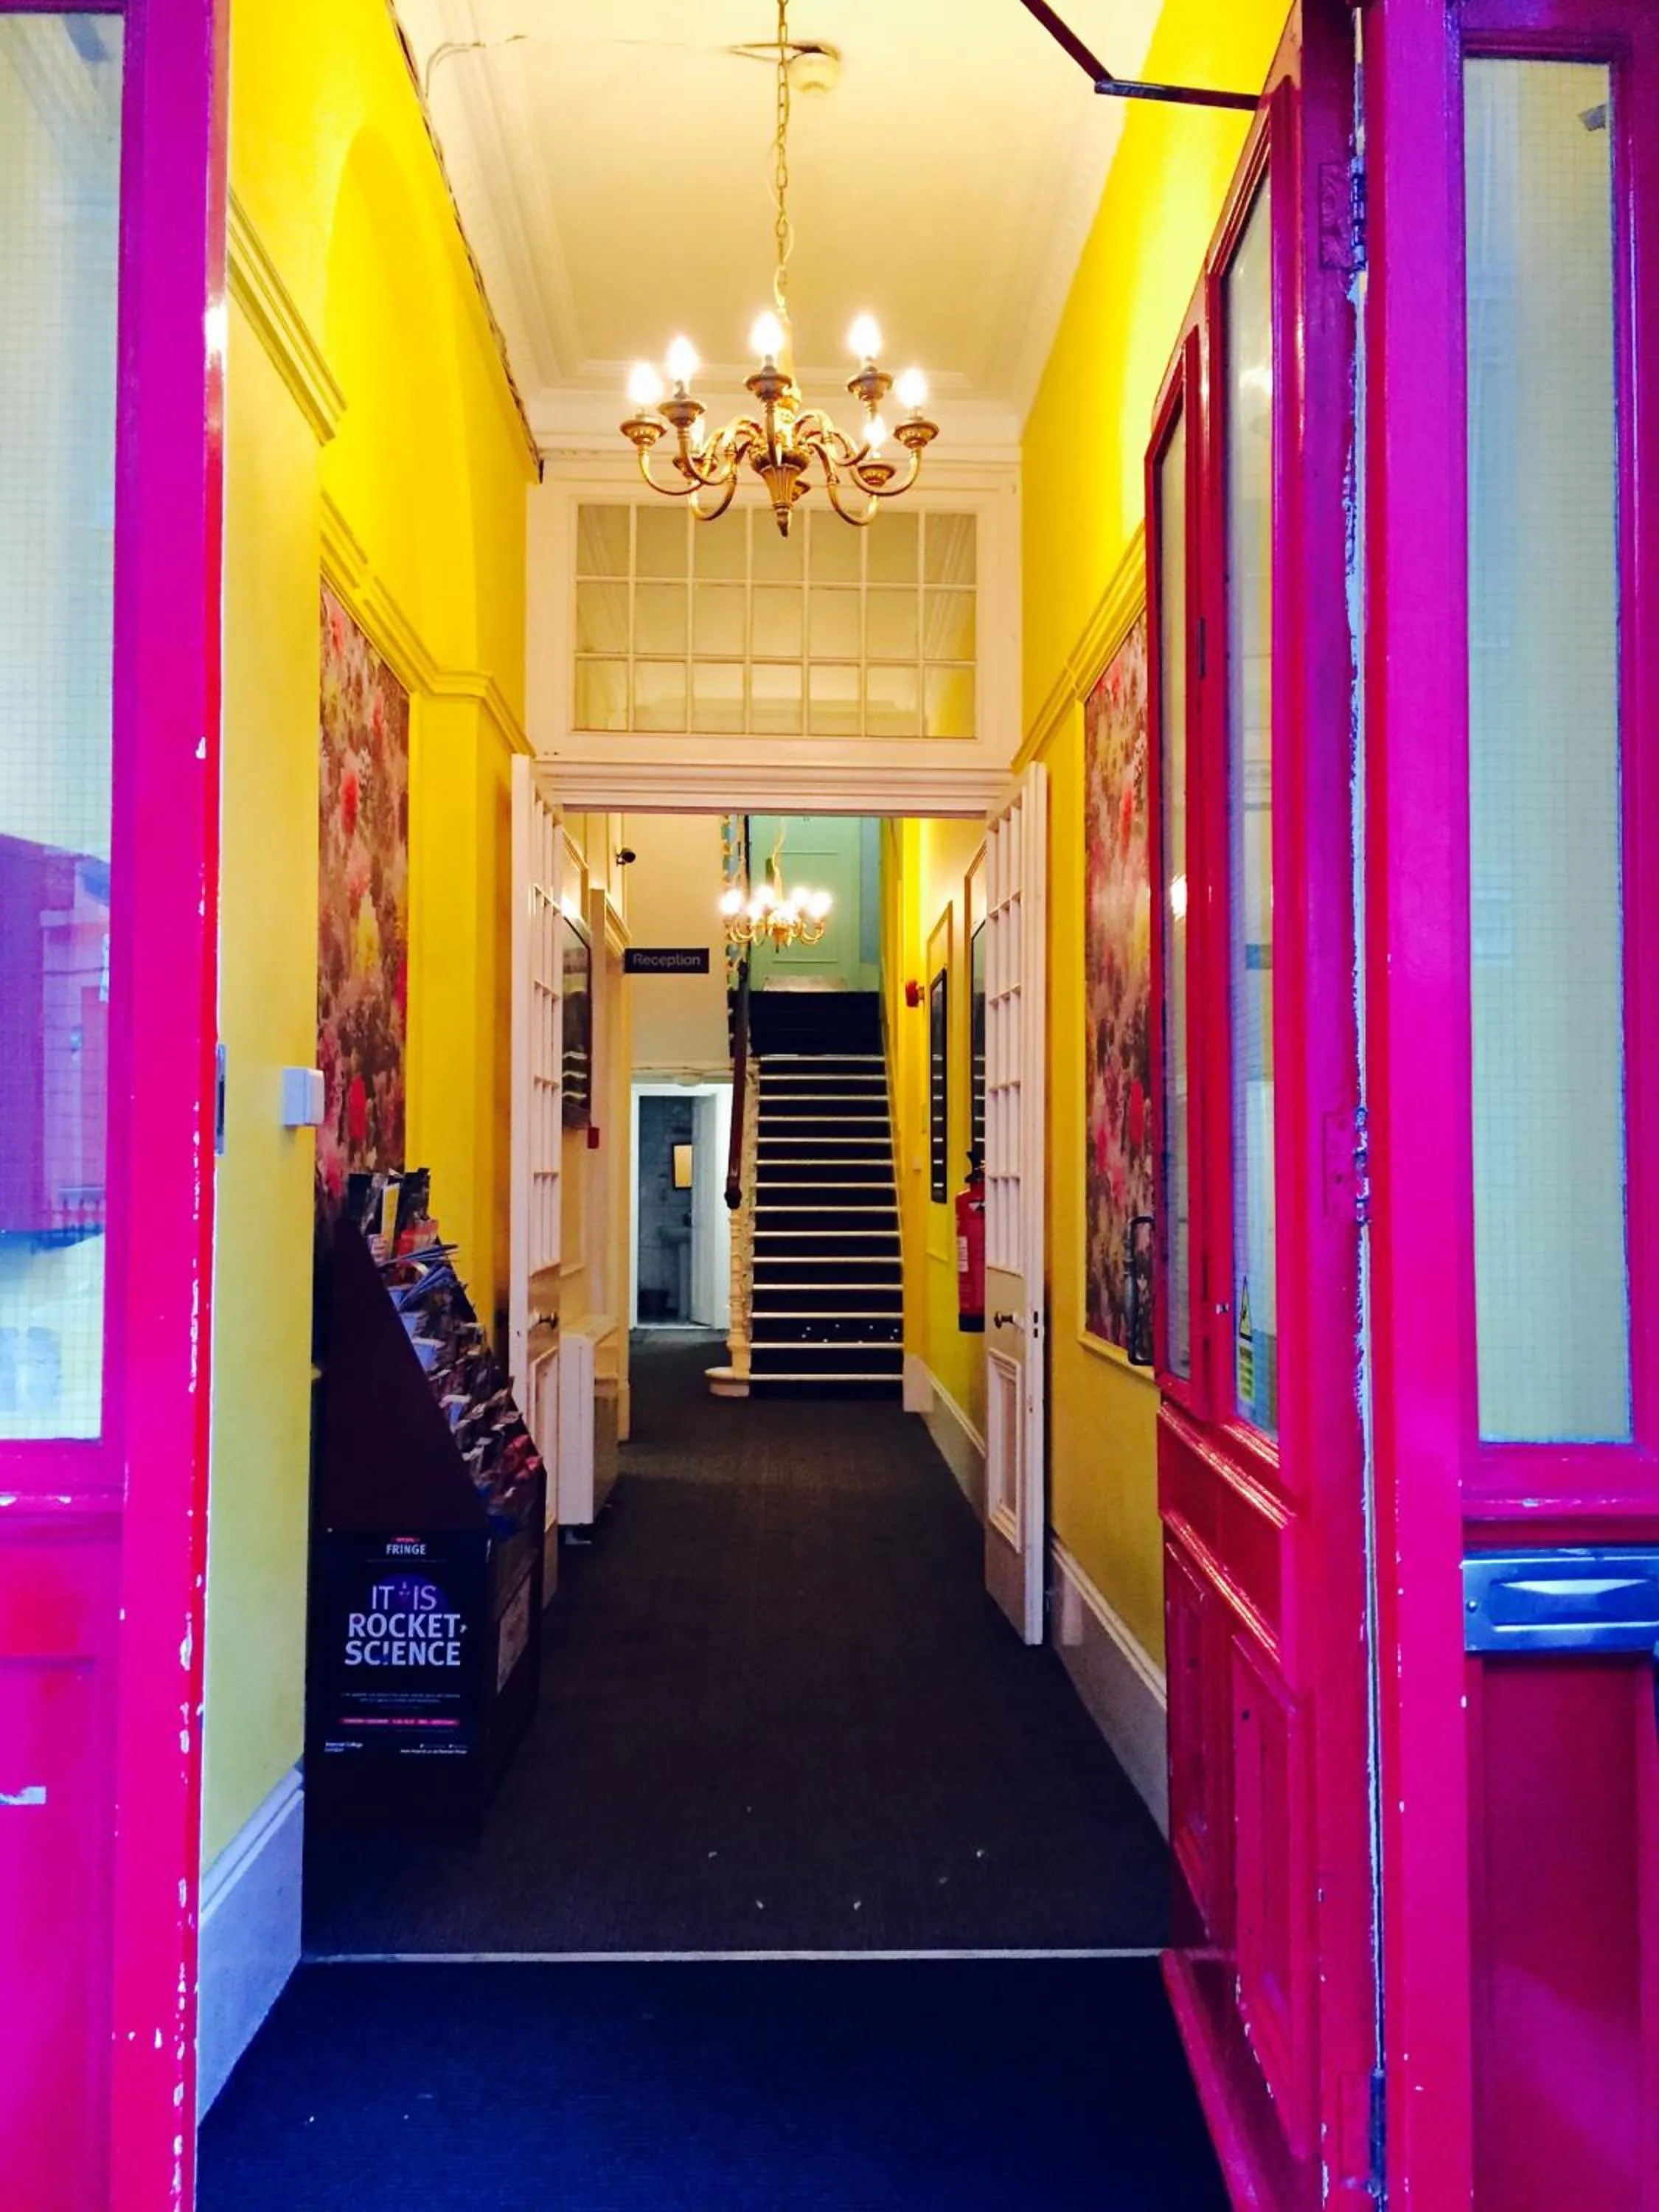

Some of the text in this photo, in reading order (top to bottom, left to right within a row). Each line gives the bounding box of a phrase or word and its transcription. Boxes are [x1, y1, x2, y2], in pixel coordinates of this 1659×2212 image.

[633, 953, 701, 968] Reception
[386, 1543, 426, 1555] FRINGE
[372, 1585, 437, 1611] IT IS
[348, 1613, 461, 1638] ROCKET
